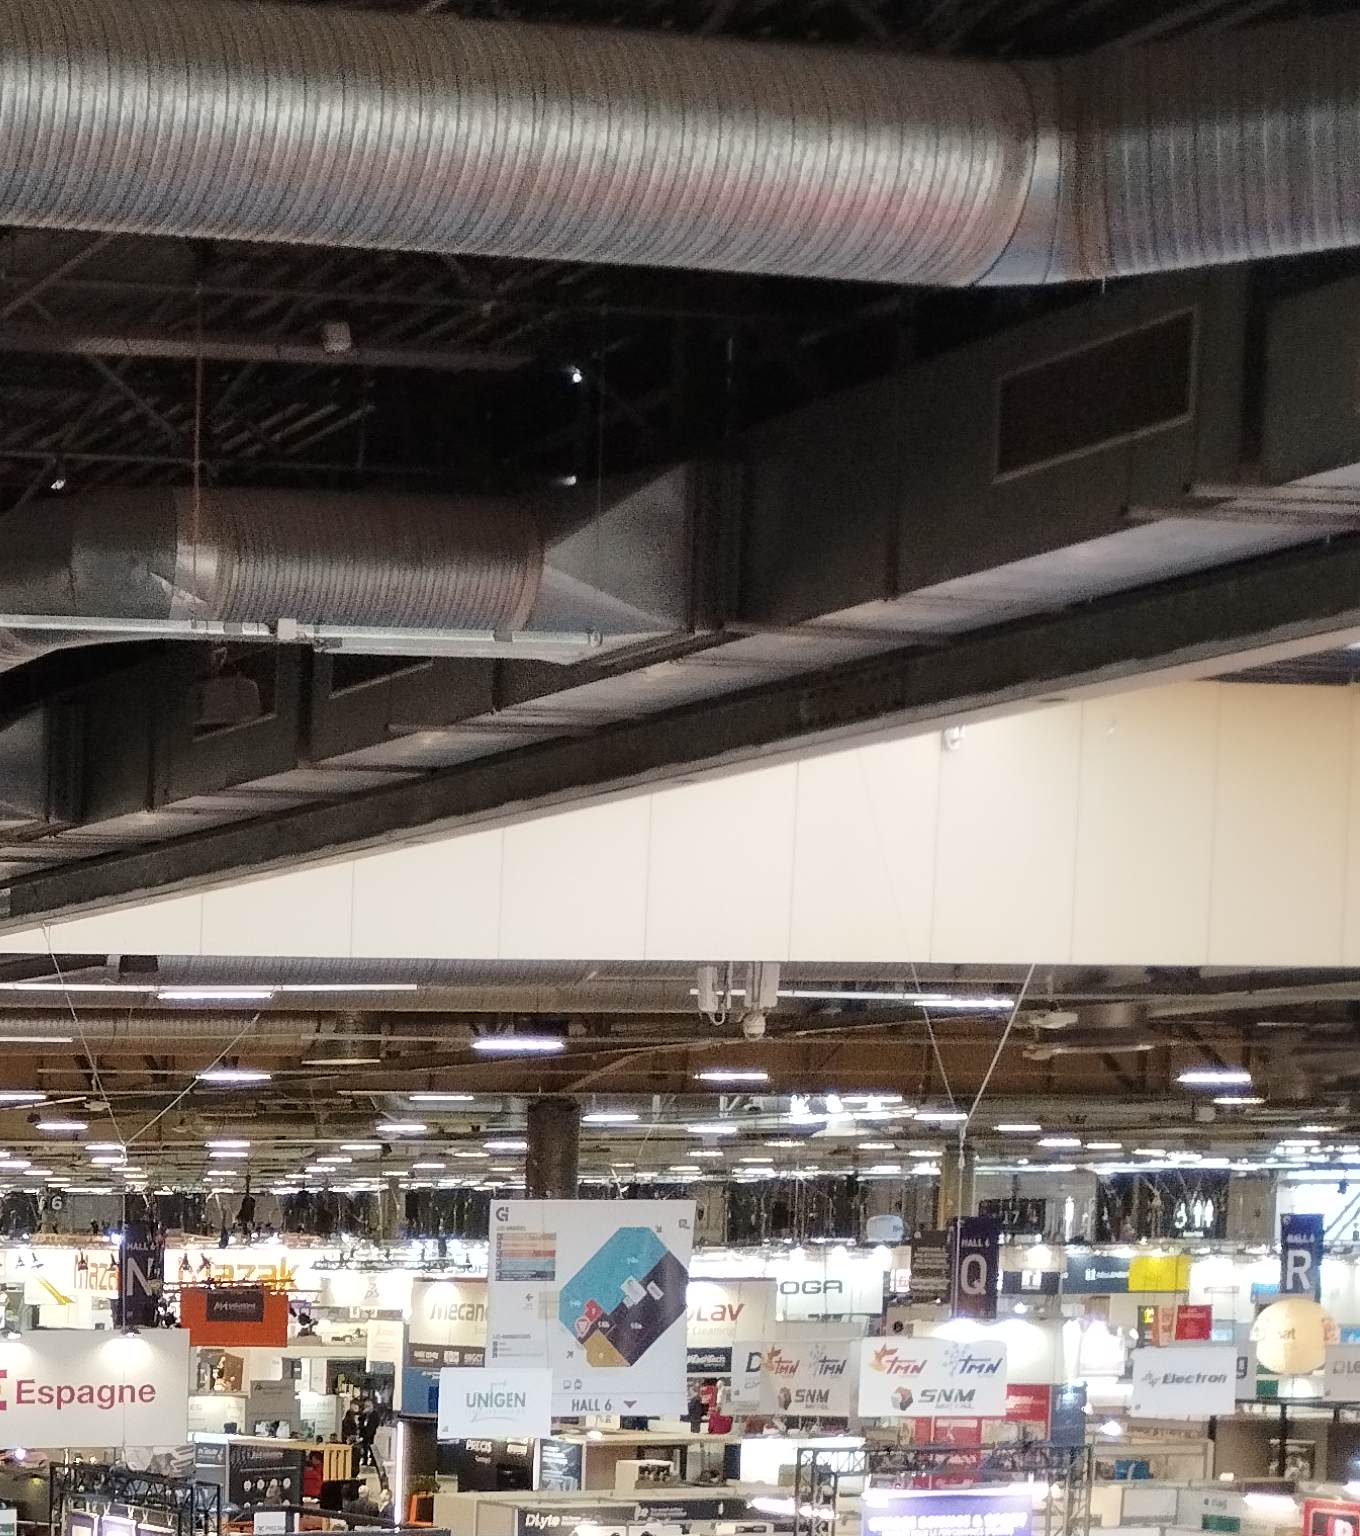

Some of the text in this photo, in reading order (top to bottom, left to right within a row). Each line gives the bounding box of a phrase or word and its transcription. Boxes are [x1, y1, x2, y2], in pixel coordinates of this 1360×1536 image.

[961, 1238, 991, 1248] HALL 6
[127, 1256, 155, 1297] N
[960, 1253, 988, 1295] Q
[1286, 1249, 1312, 1290] R
[776, 1279, 843, 1295] OGA
[886, 1355, 1003, 1375] TMN TMN
[1161, 1372, 1228, 1384] Electron
[15, 1379, 156, 1410] Espagne
[465, 1391, 526, 1408] UNIGEN
[795, 1388, 830, 1403] SNM
[917, 1388, 976, 1405] SNM
[571, 1398, 612, 1412] HALL 6
